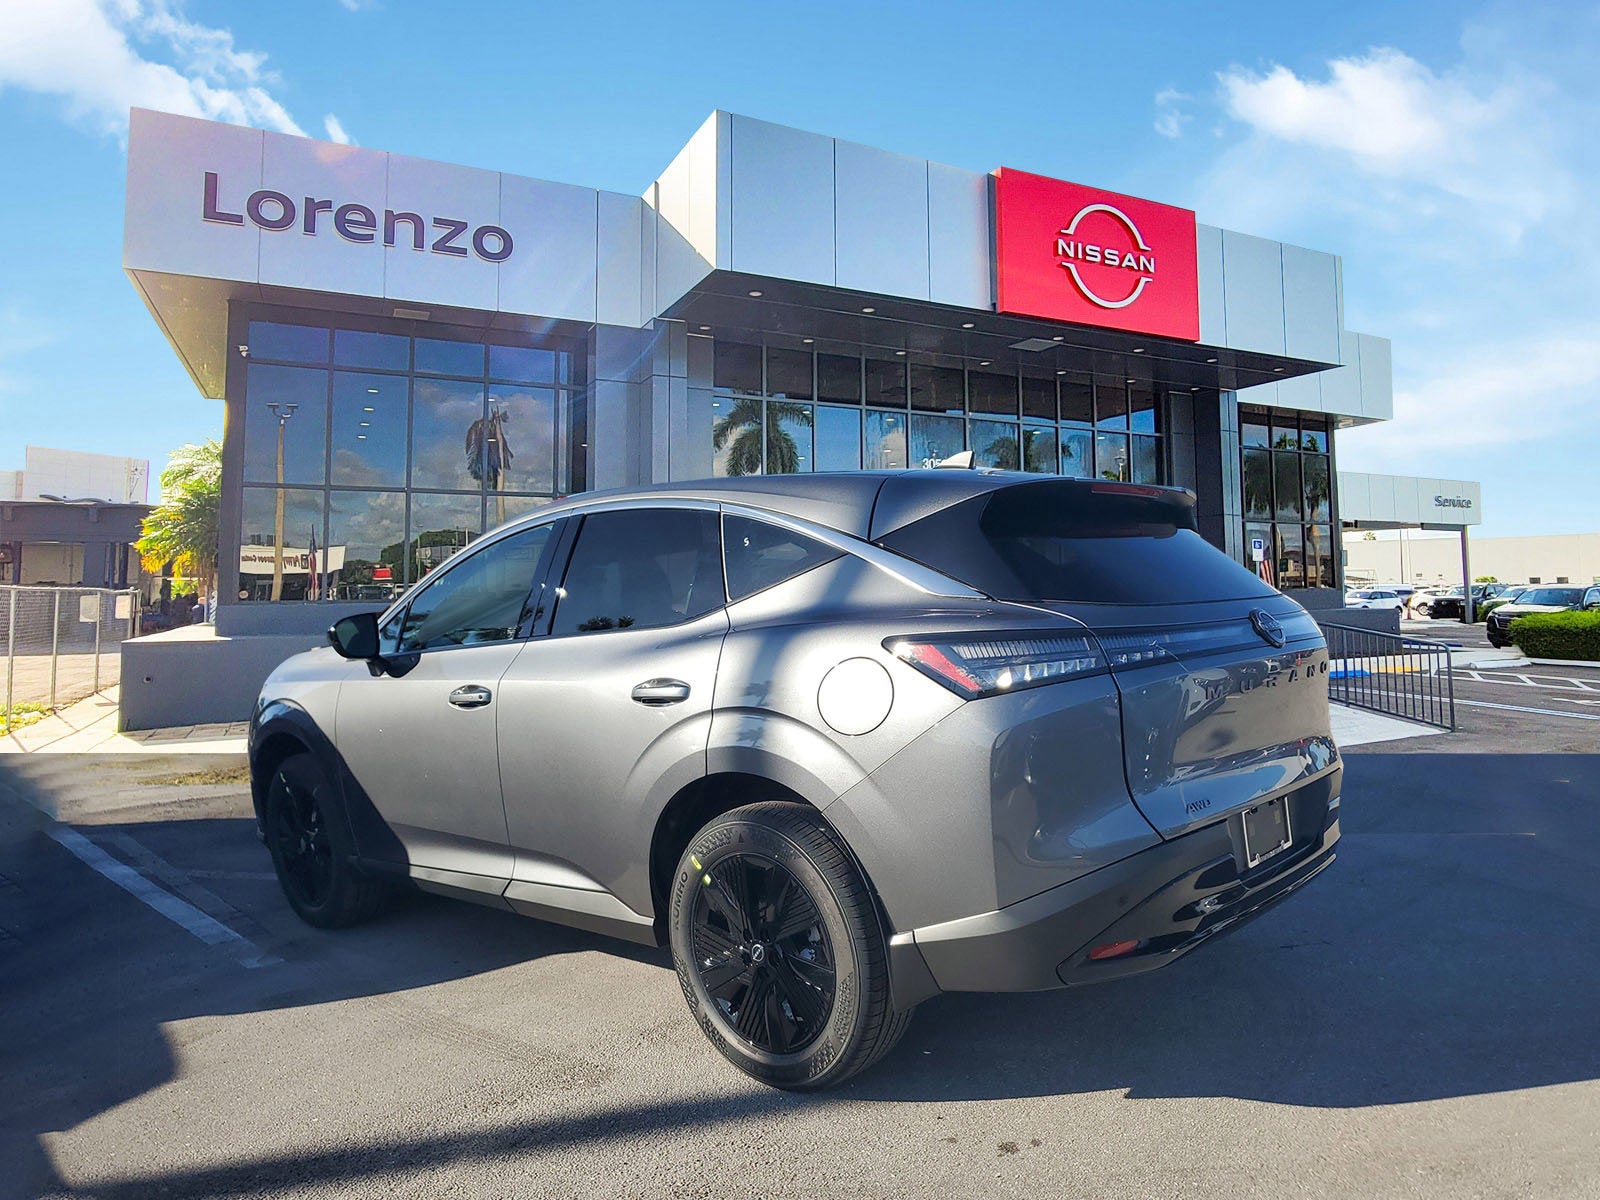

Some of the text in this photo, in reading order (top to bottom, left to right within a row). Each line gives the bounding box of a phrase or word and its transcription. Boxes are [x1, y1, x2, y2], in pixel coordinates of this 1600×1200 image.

[202, 171, 514, 262] Lorenzo
[1057, 238, 1155, 274] NISSAN
[1434, 495, 1472, 508] Service
[1205, 661, 1327, 700] MURANO
[1186, 799, 1211, 815] AWD
[673, 871, 688, 931] KUMHO
